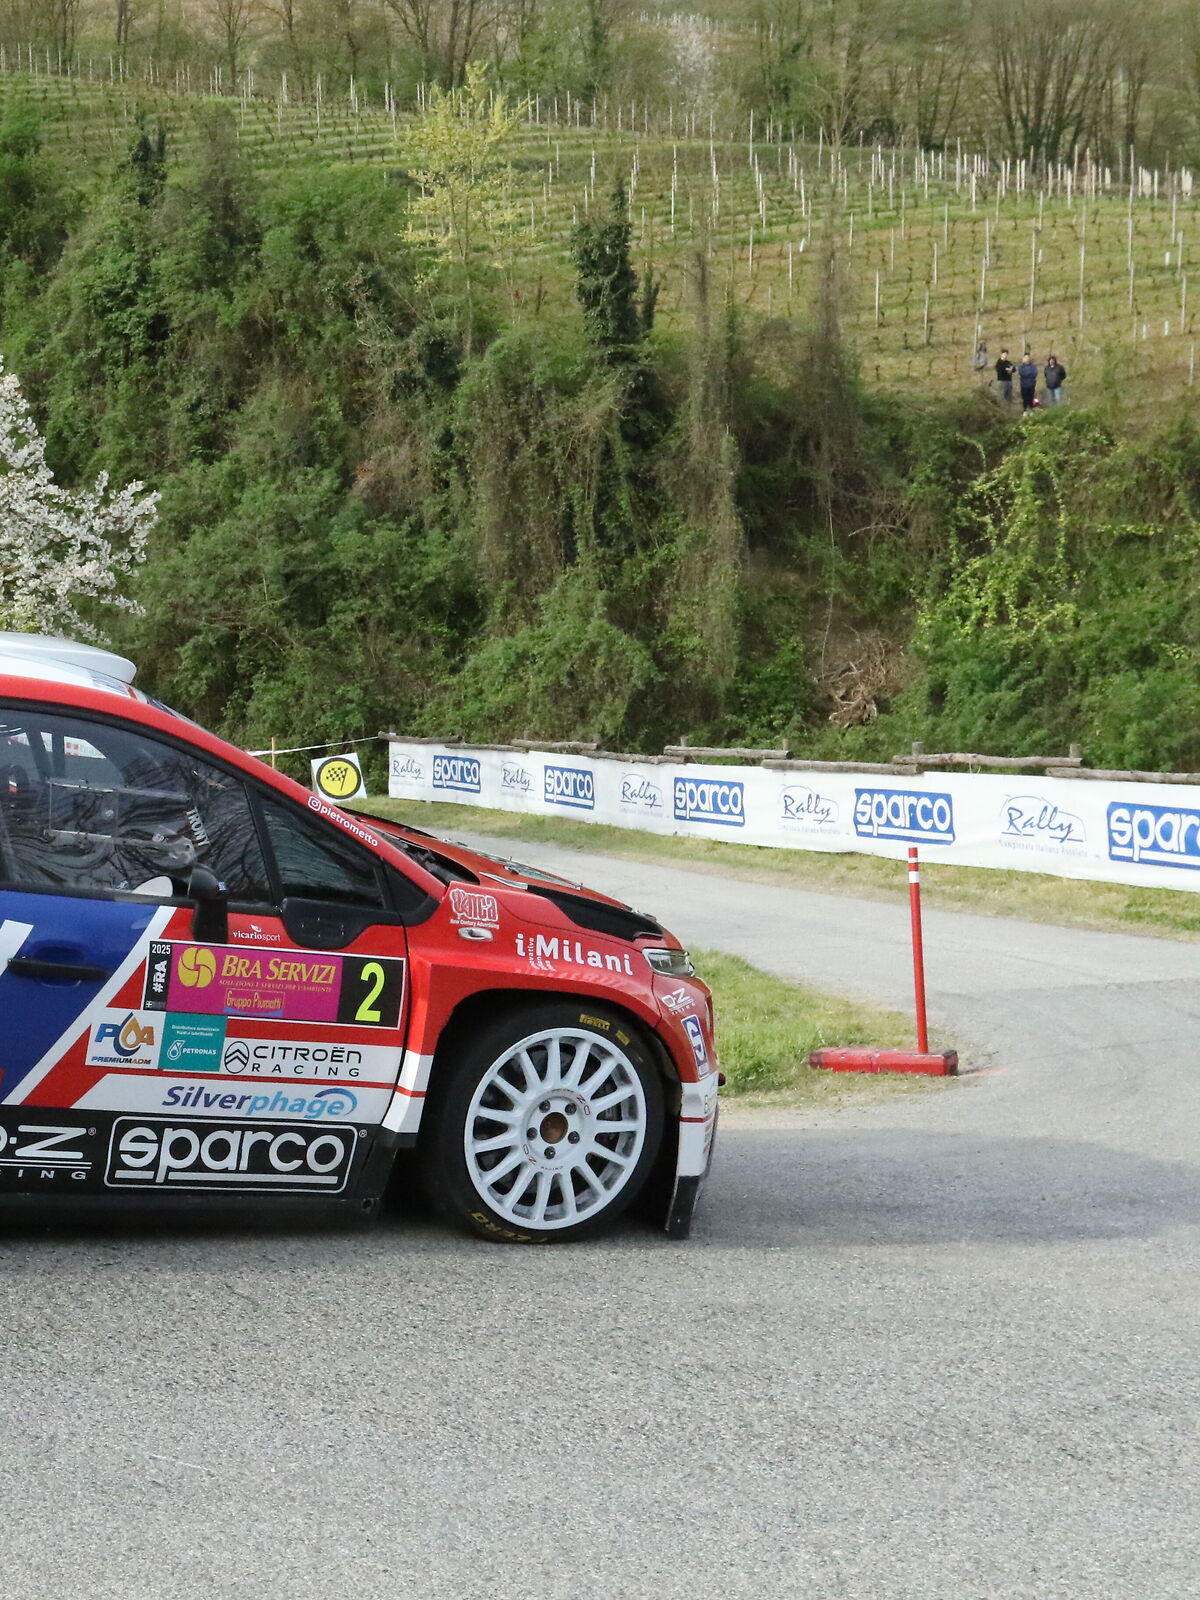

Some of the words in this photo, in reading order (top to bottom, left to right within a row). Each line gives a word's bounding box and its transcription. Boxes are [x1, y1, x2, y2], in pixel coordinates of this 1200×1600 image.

[434, 758, 479, 787] sparco
[502, 768, 530, 792] Rally
[545, 769, 593, 803] sparco
[622, 781, 657, 808] Rally
[674, 781, 744, 819] sparco
[783, 793, 831, 825] Rally
[320, 806, 379, 847] pietrometto
[855, 793, 950, 837] sparco
[1007, 805, 1074, 843] Rally
[1110, 808, 1200, 862] spar
[152, 944, 171, 955] 2025
[222, 954, 263, 979] BRA
[265, 958, 337, 985] SERVIZI
[226, 990, 252, 1009] Gruppo
[354, 962, 386, 1022] 2
[182, 1047, 217, 1055] PETRONAS
[253, 1045, 362, 1064] CITROËN
[252, 1063, 360, 1077] RACING
[161, 1086, 348, 1120] Silverphage
[118, 1126, 345, 1183] sparco
